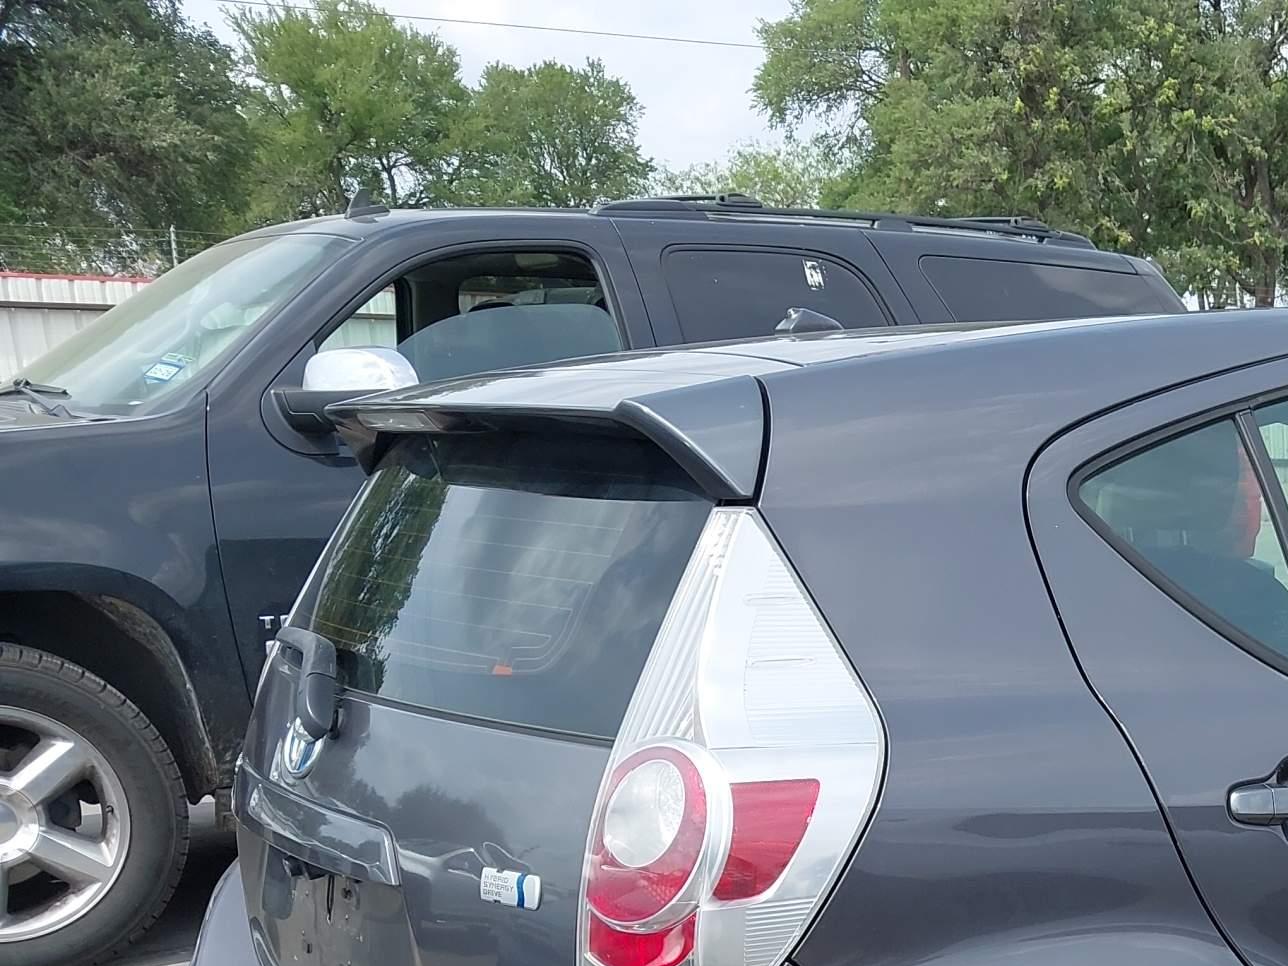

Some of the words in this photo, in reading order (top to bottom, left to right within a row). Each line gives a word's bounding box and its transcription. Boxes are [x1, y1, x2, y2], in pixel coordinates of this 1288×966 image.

[484, 873, 509, 884] HYBRID
[483, 880, 514, 893] SYNERGY
[482, 888, 503, 898] DRIVE
